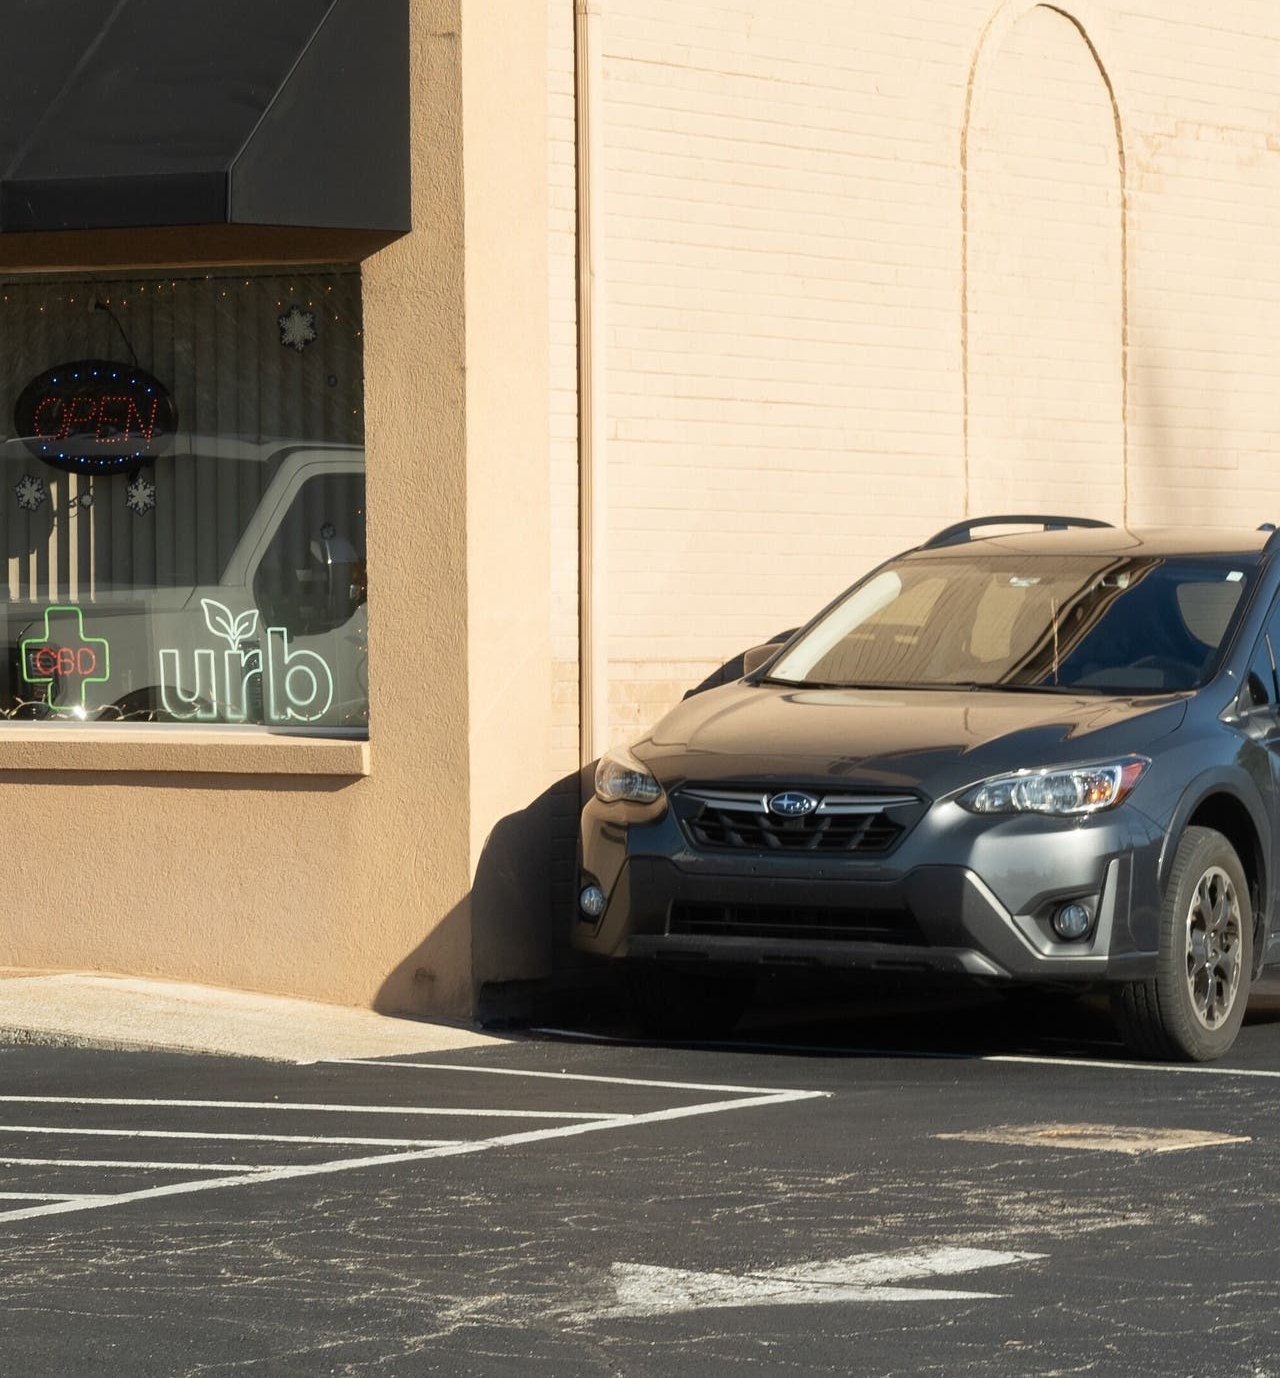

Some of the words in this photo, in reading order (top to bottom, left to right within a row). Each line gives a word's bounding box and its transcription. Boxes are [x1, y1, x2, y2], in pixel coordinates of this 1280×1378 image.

[35, 397, 158, 442] OPEN
[36, 647, 97, 676] CBD
[158, 627, 334, 722] urb
